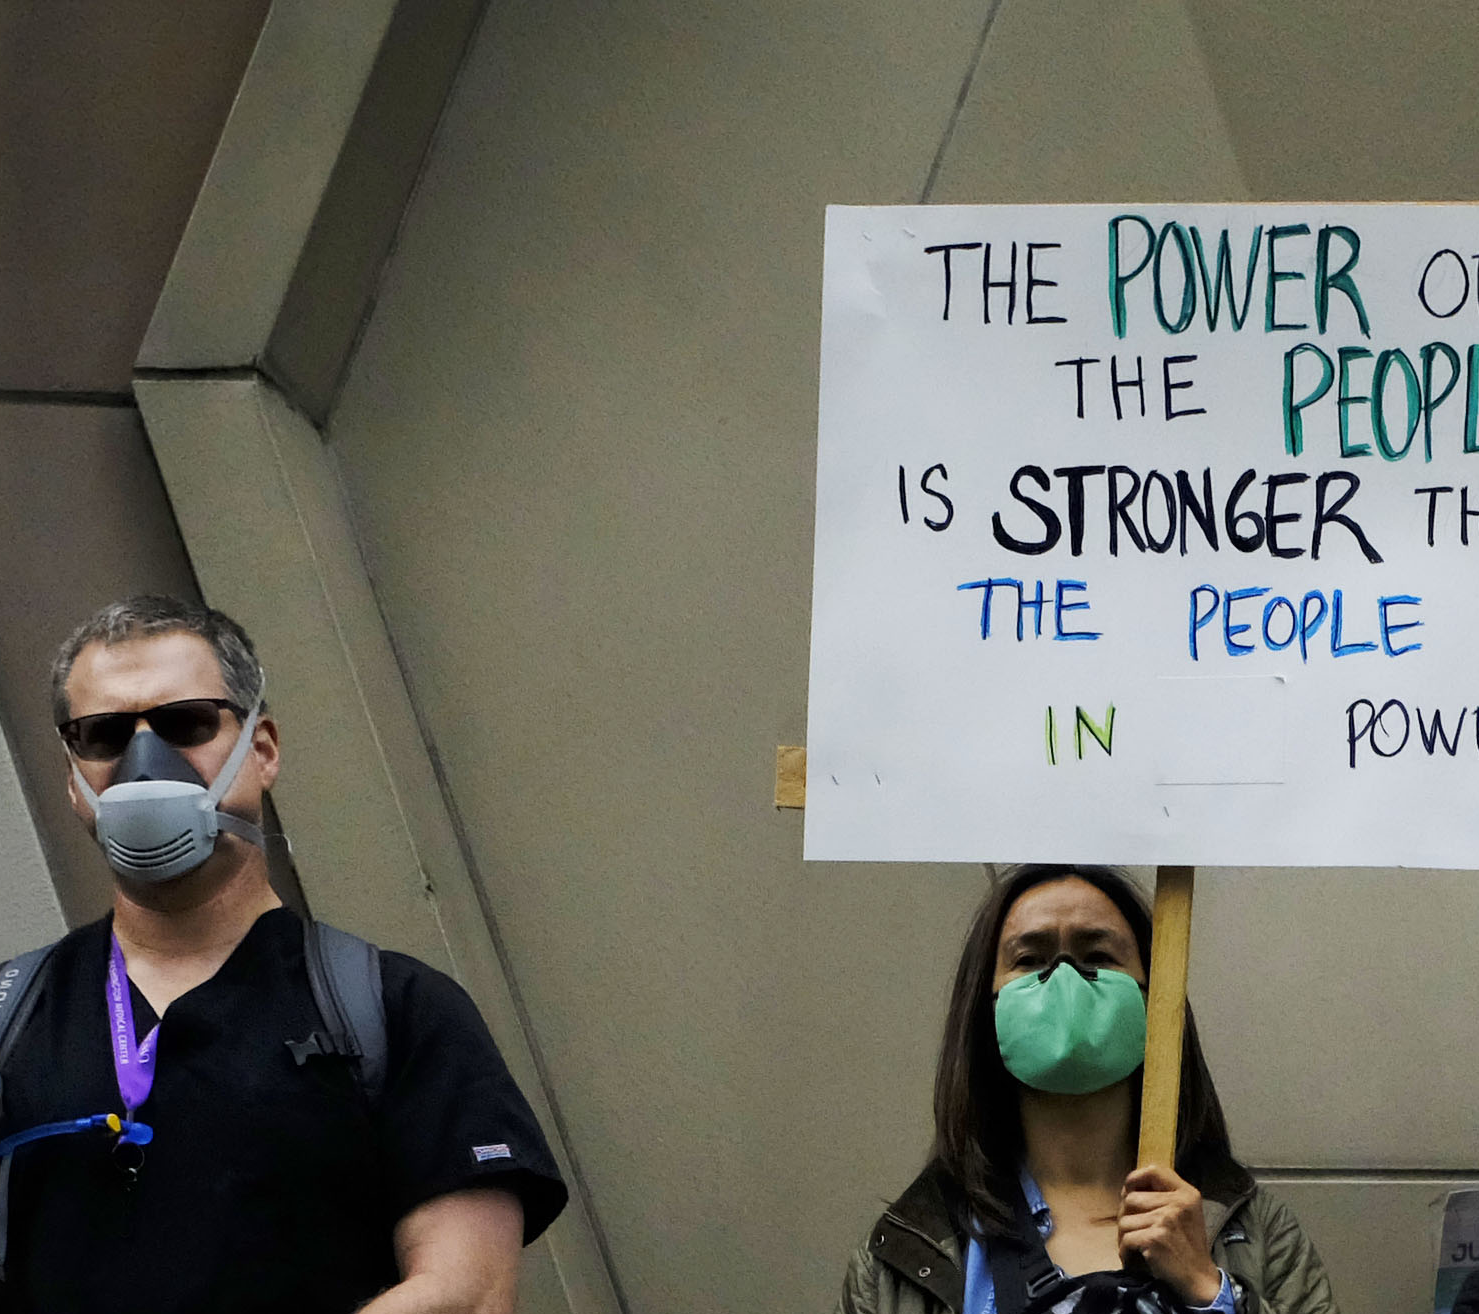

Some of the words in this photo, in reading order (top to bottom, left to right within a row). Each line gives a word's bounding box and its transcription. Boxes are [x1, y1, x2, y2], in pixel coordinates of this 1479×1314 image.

[924, 242, 1067, 326] THE
[1108, 215, 1372, 338] POWER
[1056, 354, 1207, 421] THE
[898, 465, 954, 532] IS
[992, 465, 1385, 563] STRONGER
[957, 579, 1102, 643] THE
[1189, 584, 1425, 662] PEOPLE
[1045, 702, 1116, 765] IN
